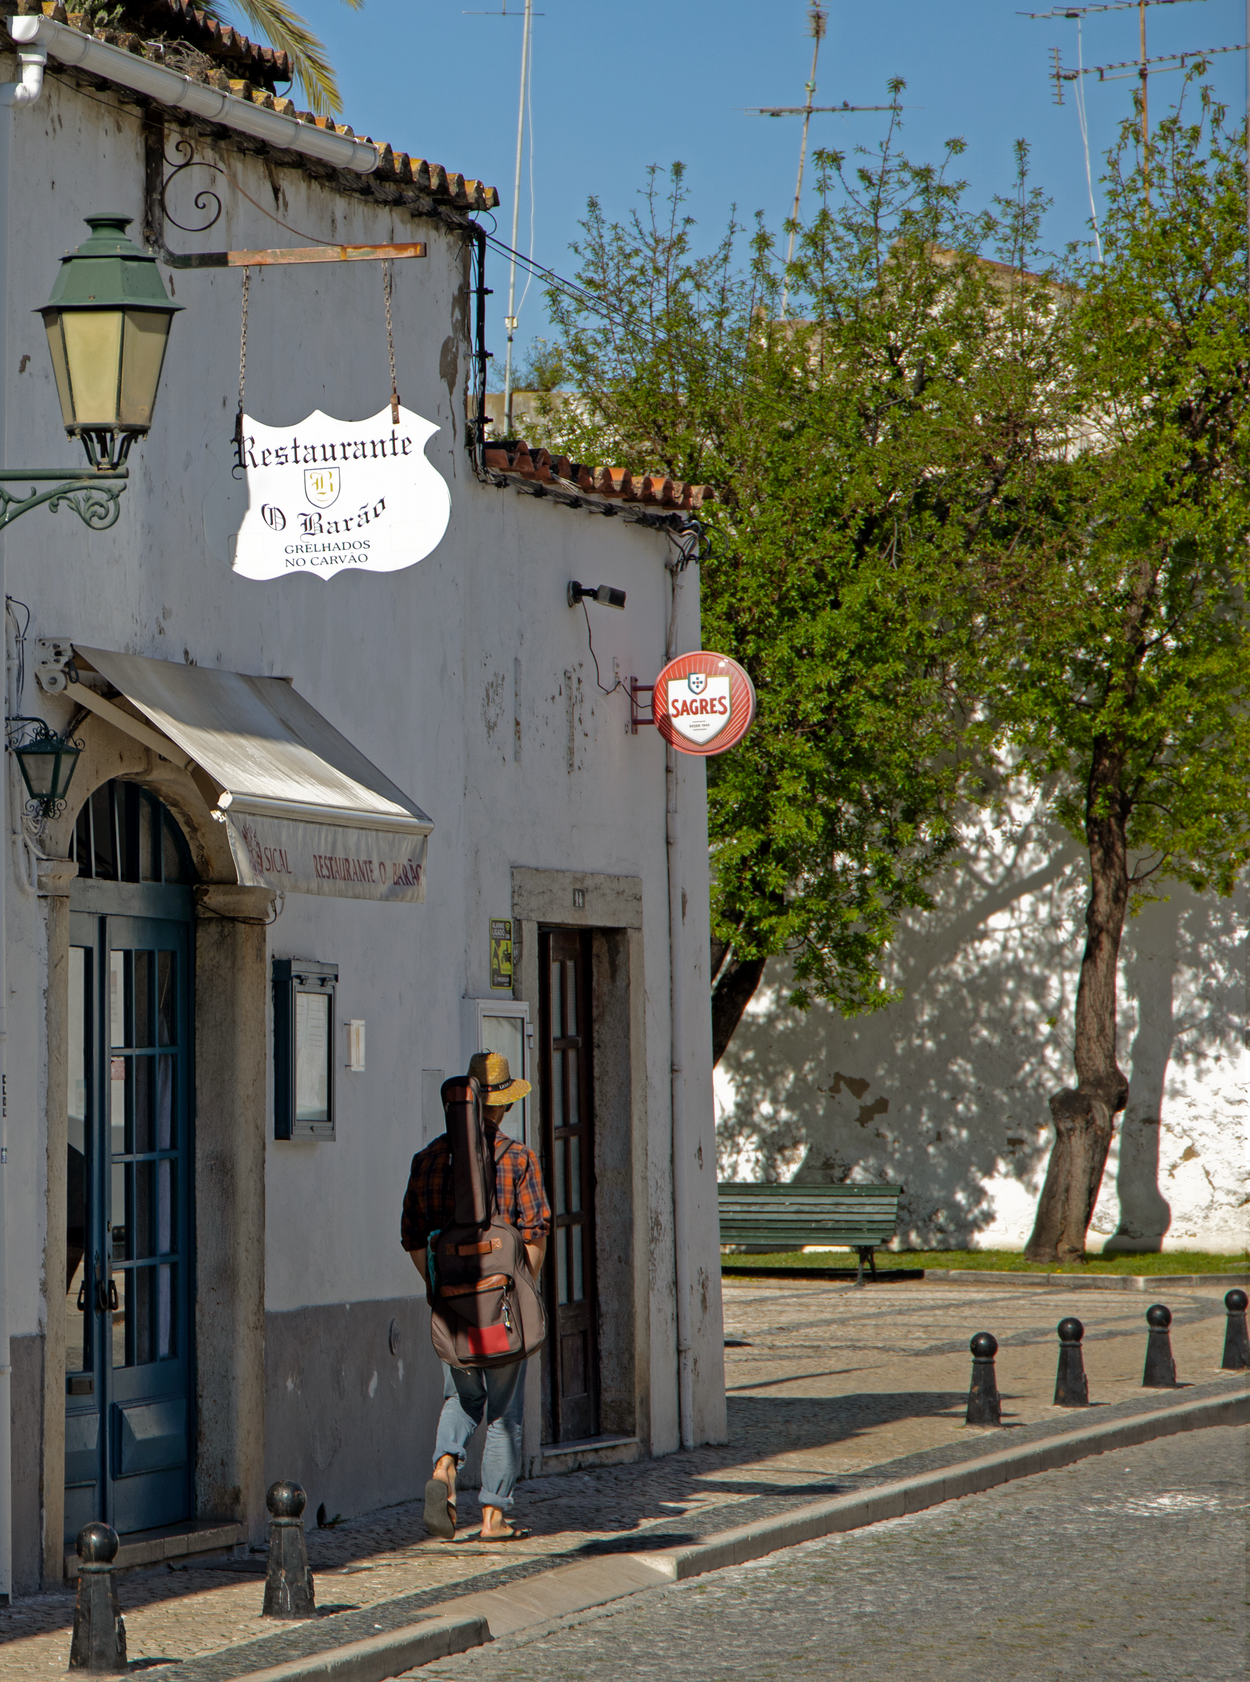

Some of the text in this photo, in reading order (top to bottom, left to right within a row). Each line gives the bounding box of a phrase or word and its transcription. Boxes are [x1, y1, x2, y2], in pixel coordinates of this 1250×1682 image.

[231, 429, 412, 480] Restaurante
[261, 496, 387, 543] O Barão
[284, 540, 371, 555] GRELHADOS
[285, 552, 368, 567] NO CARVÃO
[671, 695, 728, 718] SAGRES
[264, 846, 423, 886] SICAL RESTAURANTE O BARÃO
